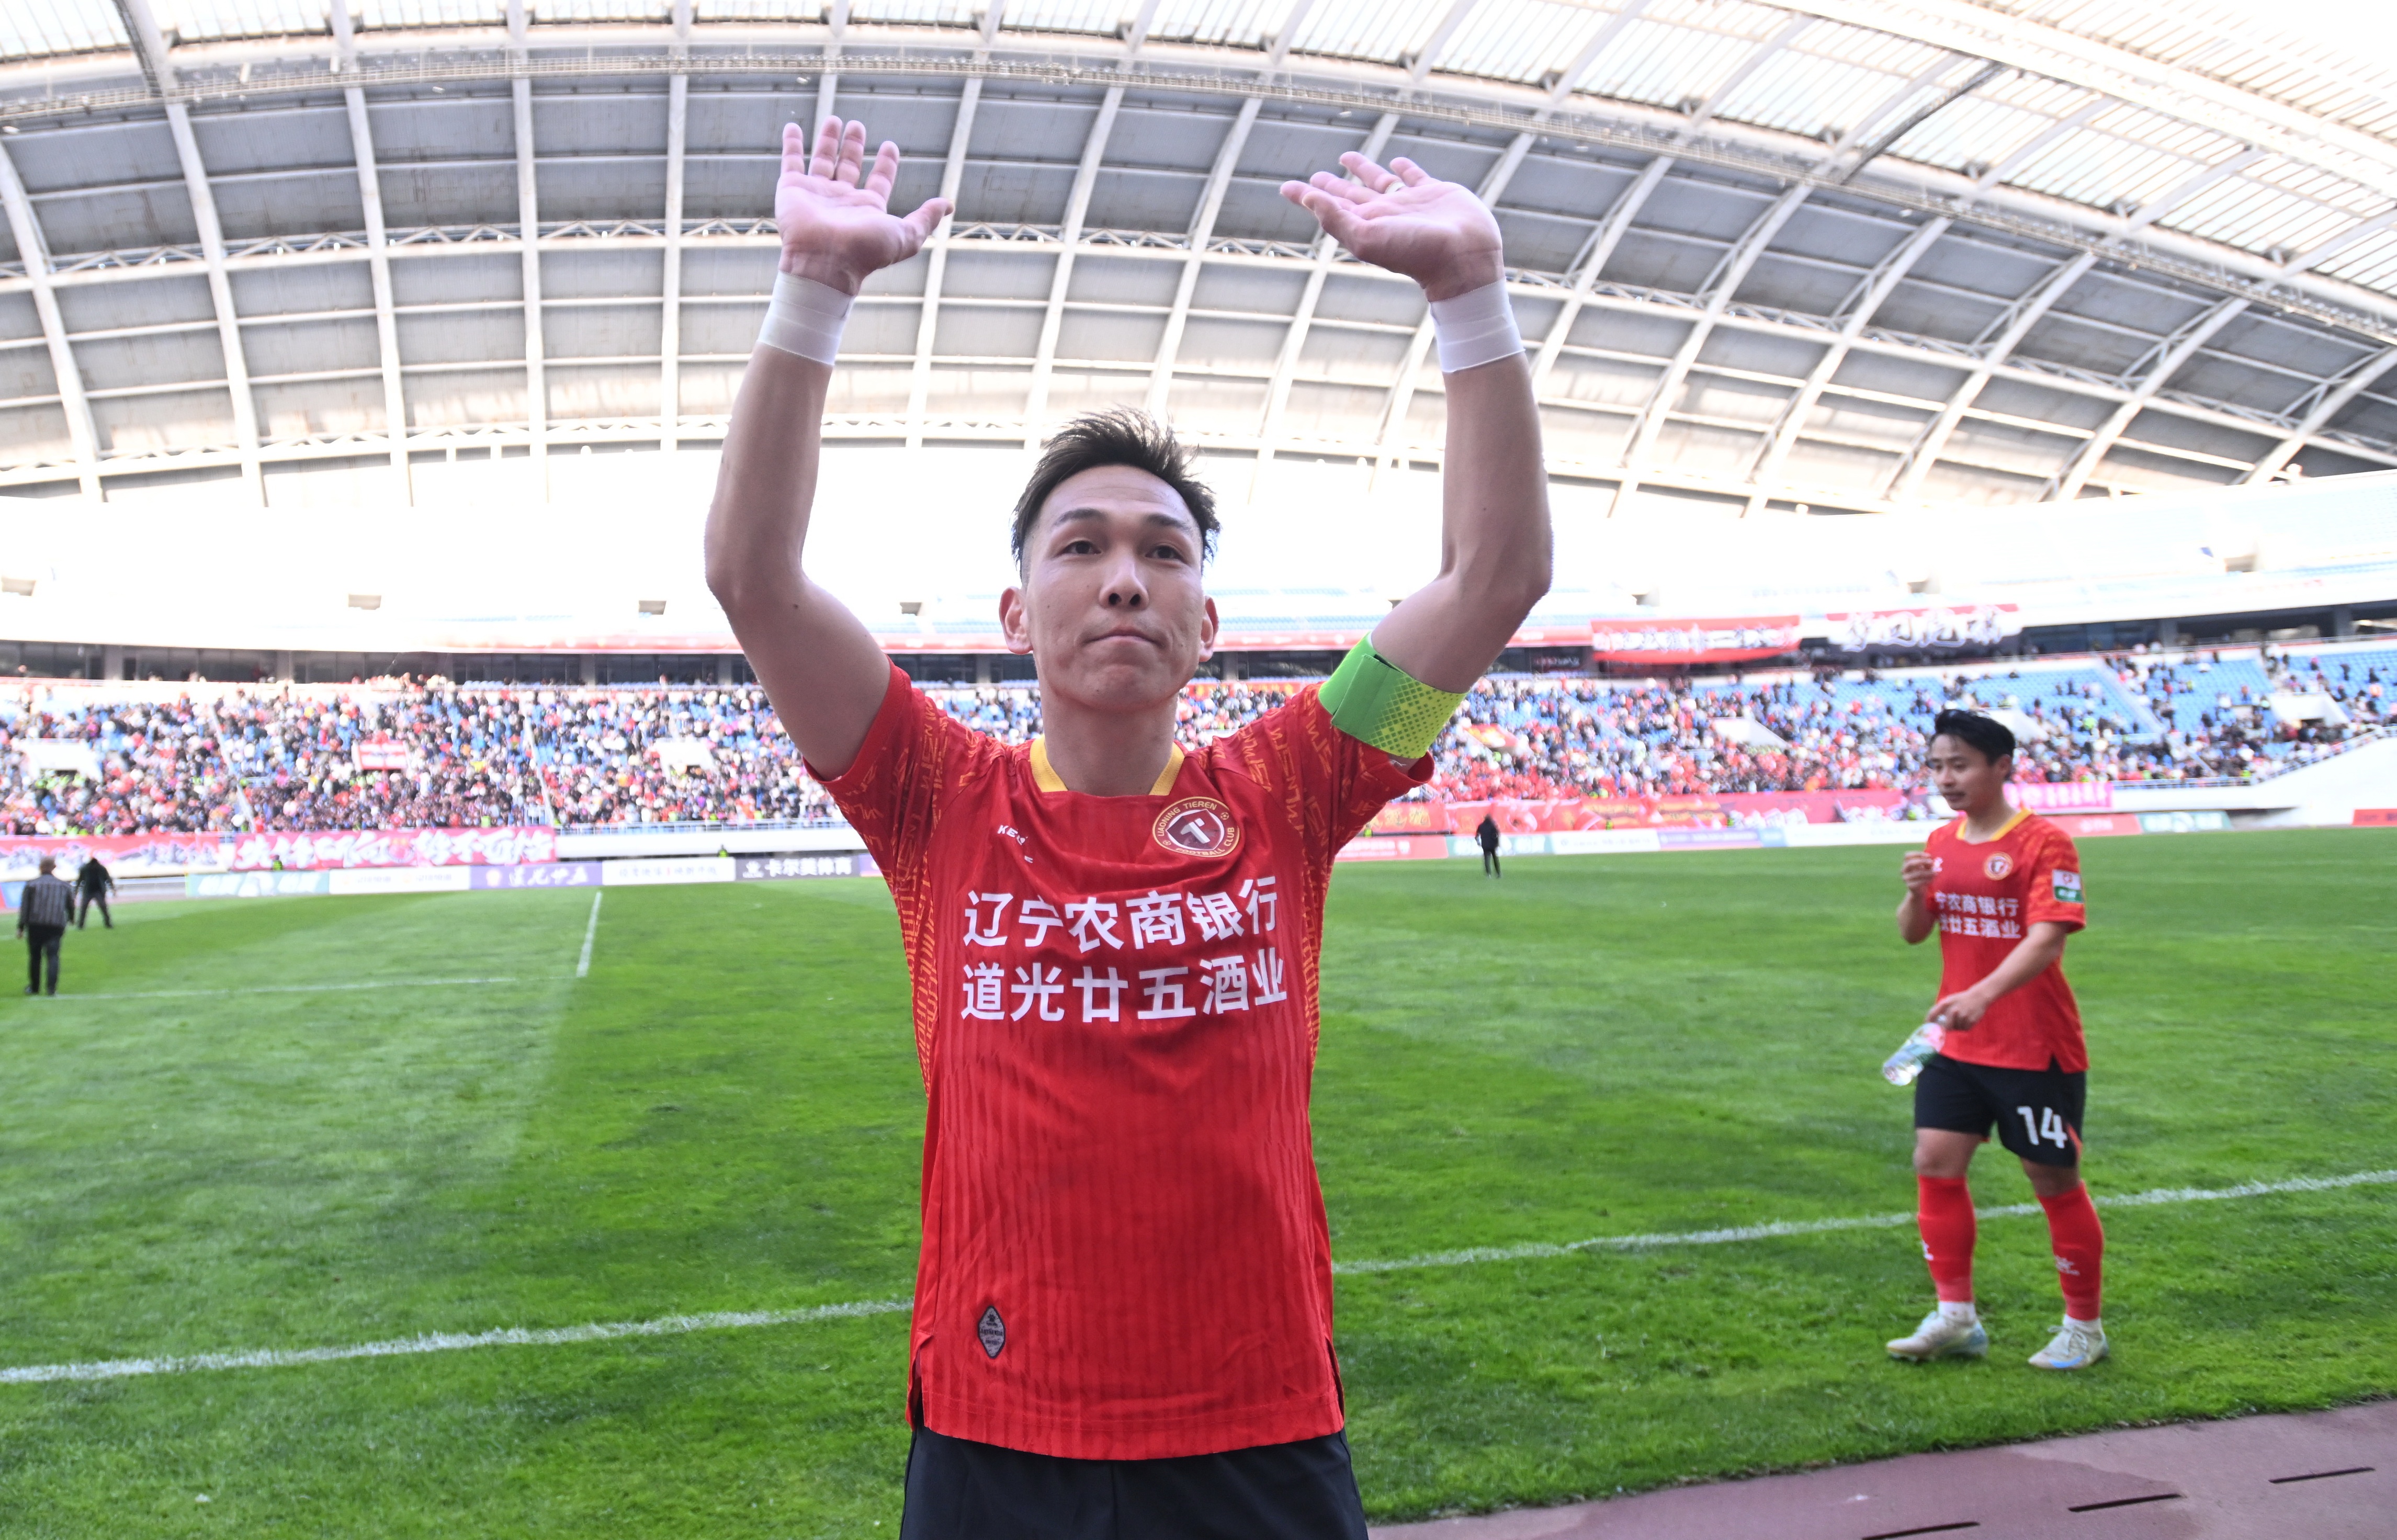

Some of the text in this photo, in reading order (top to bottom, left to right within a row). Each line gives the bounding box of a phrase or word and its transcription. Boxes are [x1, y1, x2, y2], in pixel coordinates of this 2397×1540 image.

[1158, 801, 1217, 836] LIAONING TIEREN
[1176, 827, 1235, 856] FOOTBALL CLUB
[765, 857, 851, 877] 卡尔美体育
[963, 876, 1277, 953] 辽宁农商银行
[961, 947, 1287, 1023] 道光廿五酒业
[2017, 1106, 2067, 1149] 14
